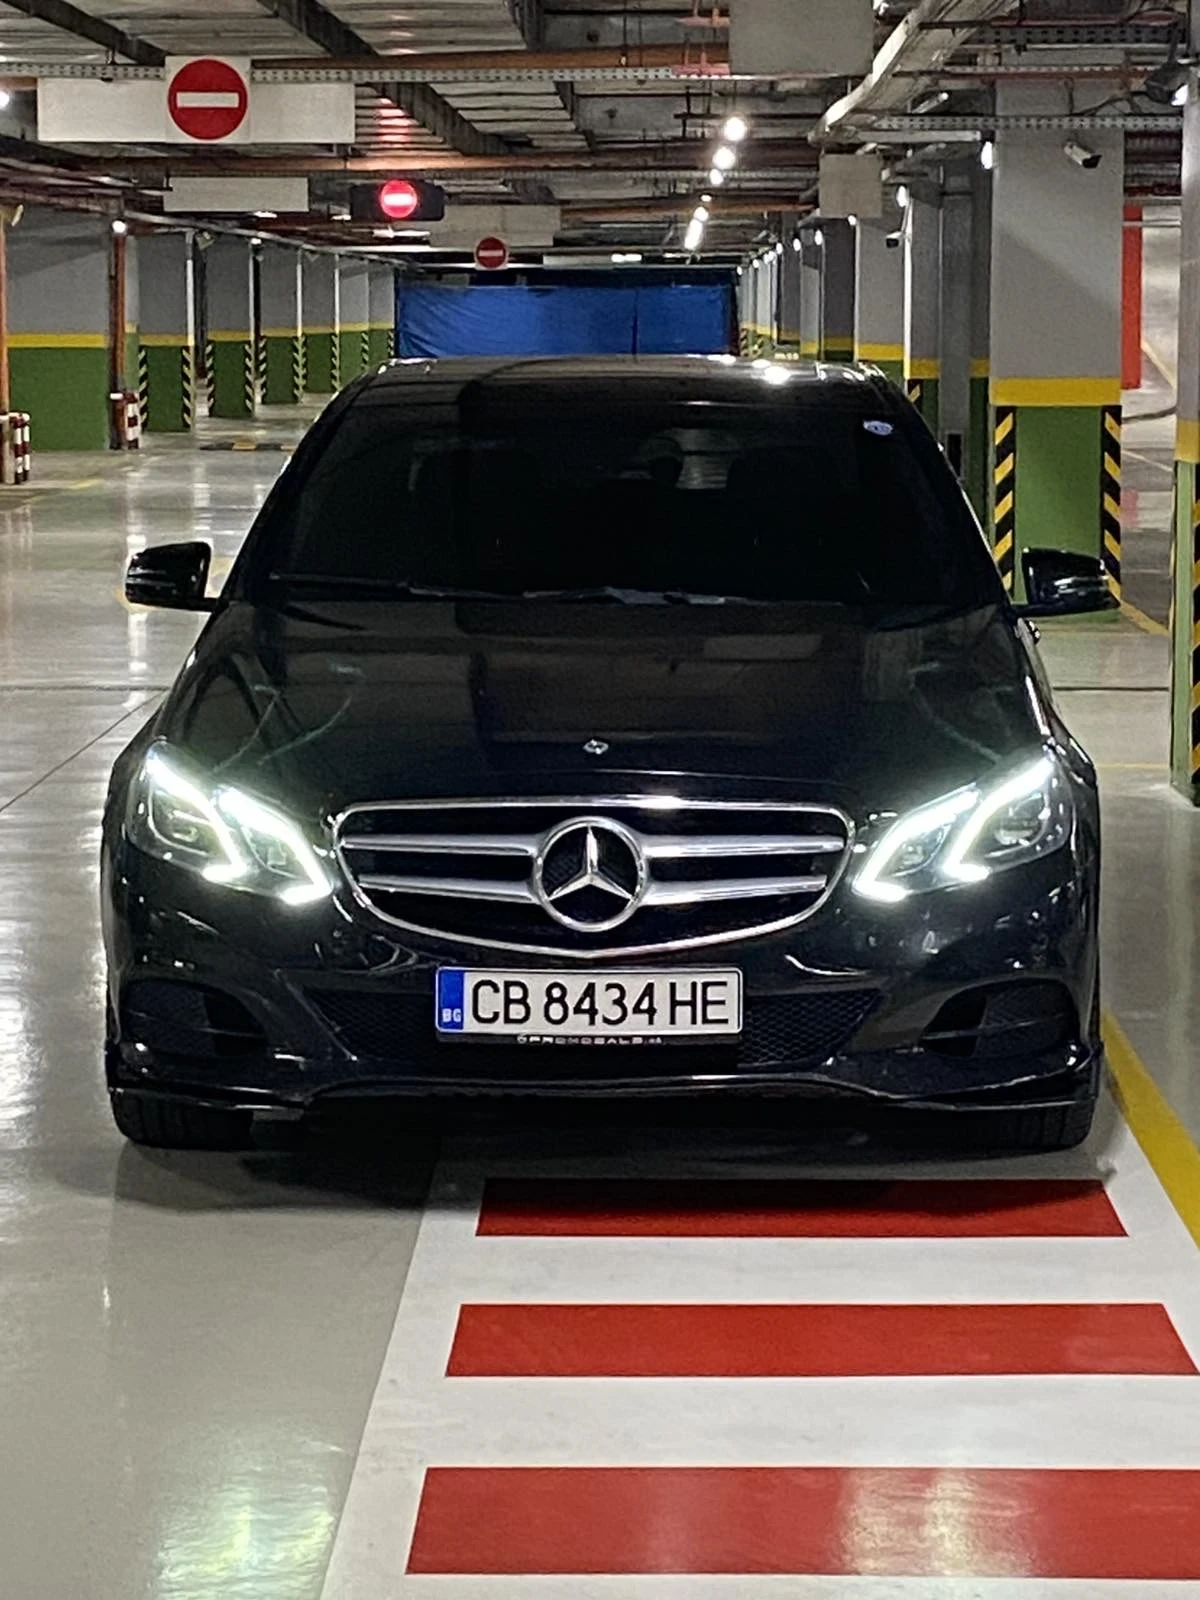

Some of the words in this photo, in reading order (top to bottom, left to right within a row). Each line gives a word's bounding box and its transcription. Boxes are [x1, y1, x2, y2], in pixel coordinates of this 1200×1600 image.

[442, 1008, 462, 1022] BG
[472, 979, 531, 1025] CB
[543, 981, 658, 1026] 8434
[669, 981, 729, 1025] HE
